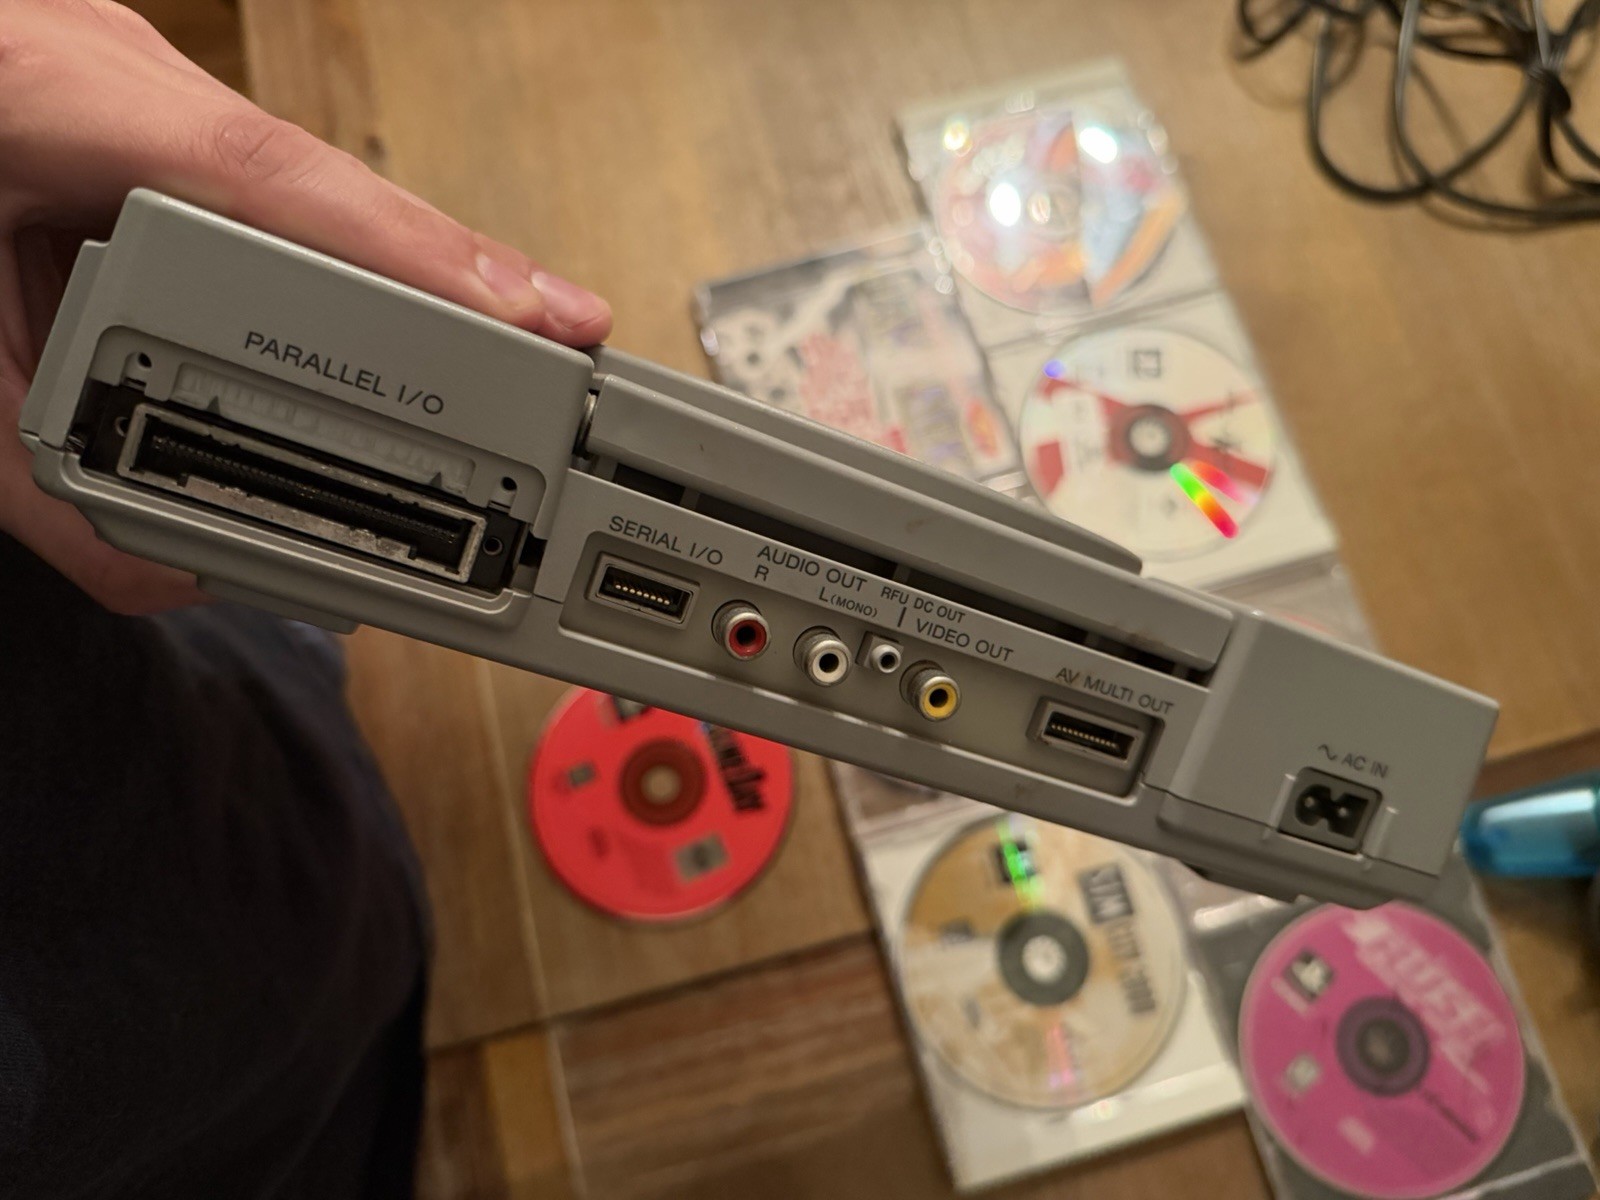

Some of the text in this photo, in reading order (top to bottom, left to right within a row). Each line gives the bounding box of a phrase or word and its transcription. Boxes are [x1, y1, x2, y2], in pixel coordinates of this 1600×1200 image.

[244, 331, 445, 415] PARALLEL I/O
[608, 515, 723, 566] SERIAL I/O
[754, 564, 770, 582] R
[757, 545, 868, 592] AUDIO OUT
[880, 586, 966, 624] RFU DC OUT
[916, 618, 1014, 662] VIDEO OUT
[1055, 667, 1175, 715] AV MULTI OUT
[1341, 752, 1389, 780] AC IN
